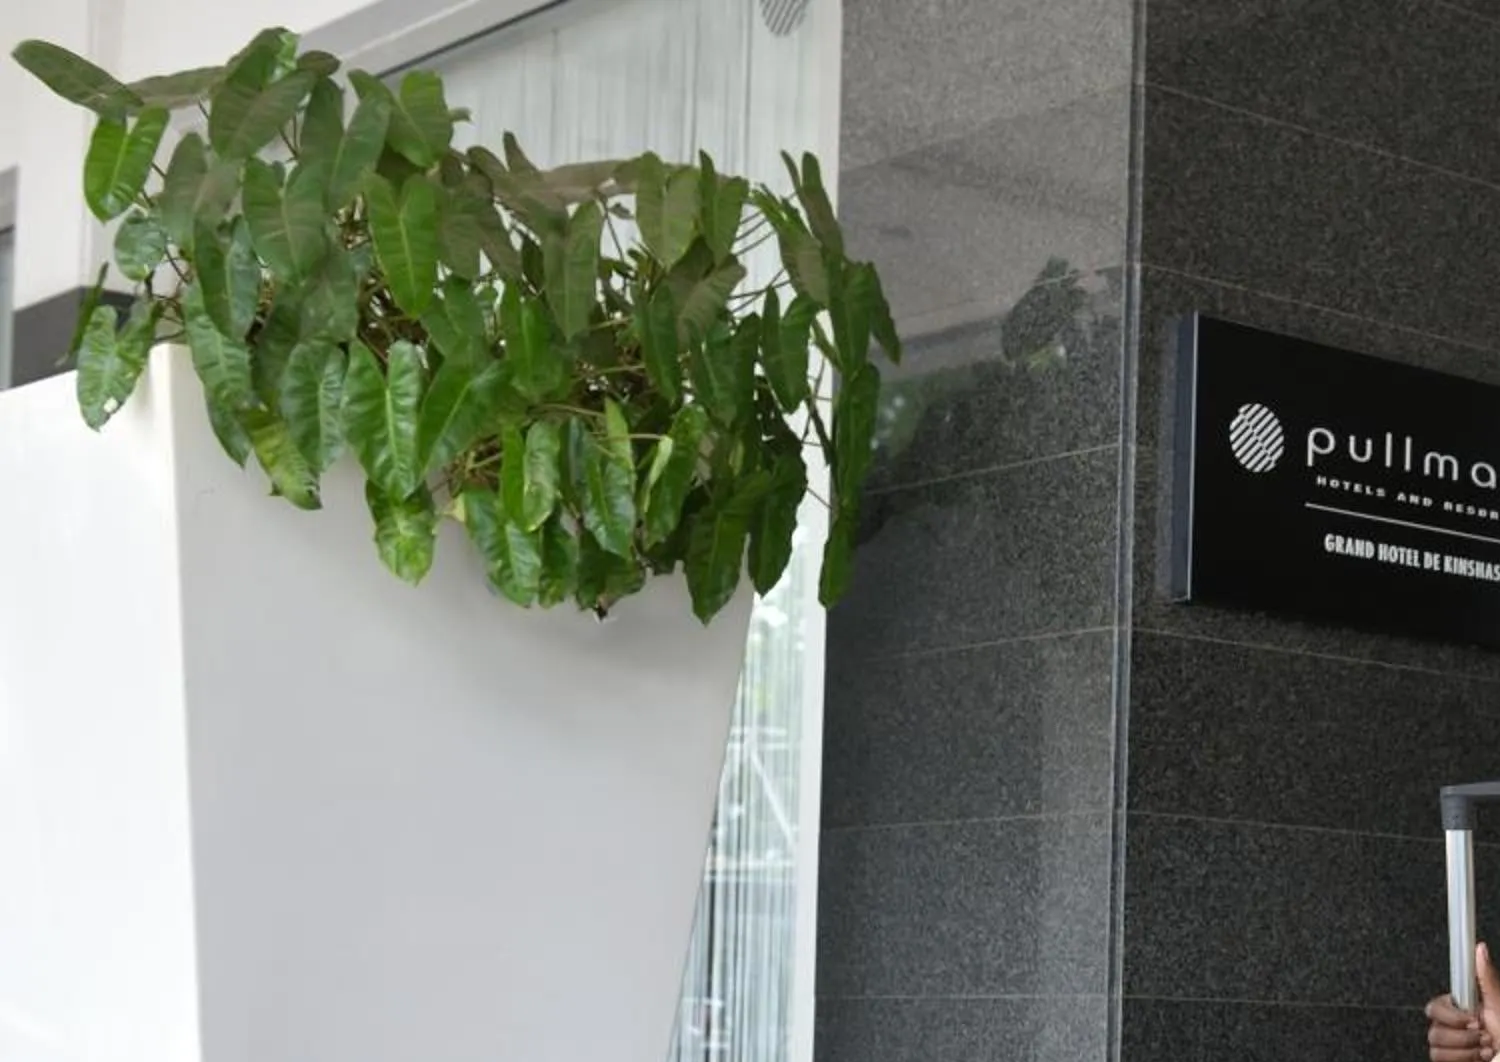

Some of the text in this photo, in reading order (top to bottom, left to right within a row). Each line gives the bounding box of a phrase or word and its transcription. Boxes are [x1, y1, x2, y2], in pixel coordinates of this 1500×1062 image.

[1316, 475, 1386, 498] HOTELS
[1397, 492, 1433, 508] AND
[1324, 533, 1375, 559] GRAND
[1378, 543, 1421, 568] HOTEL
[1423, 551, 1441, 571] DE
